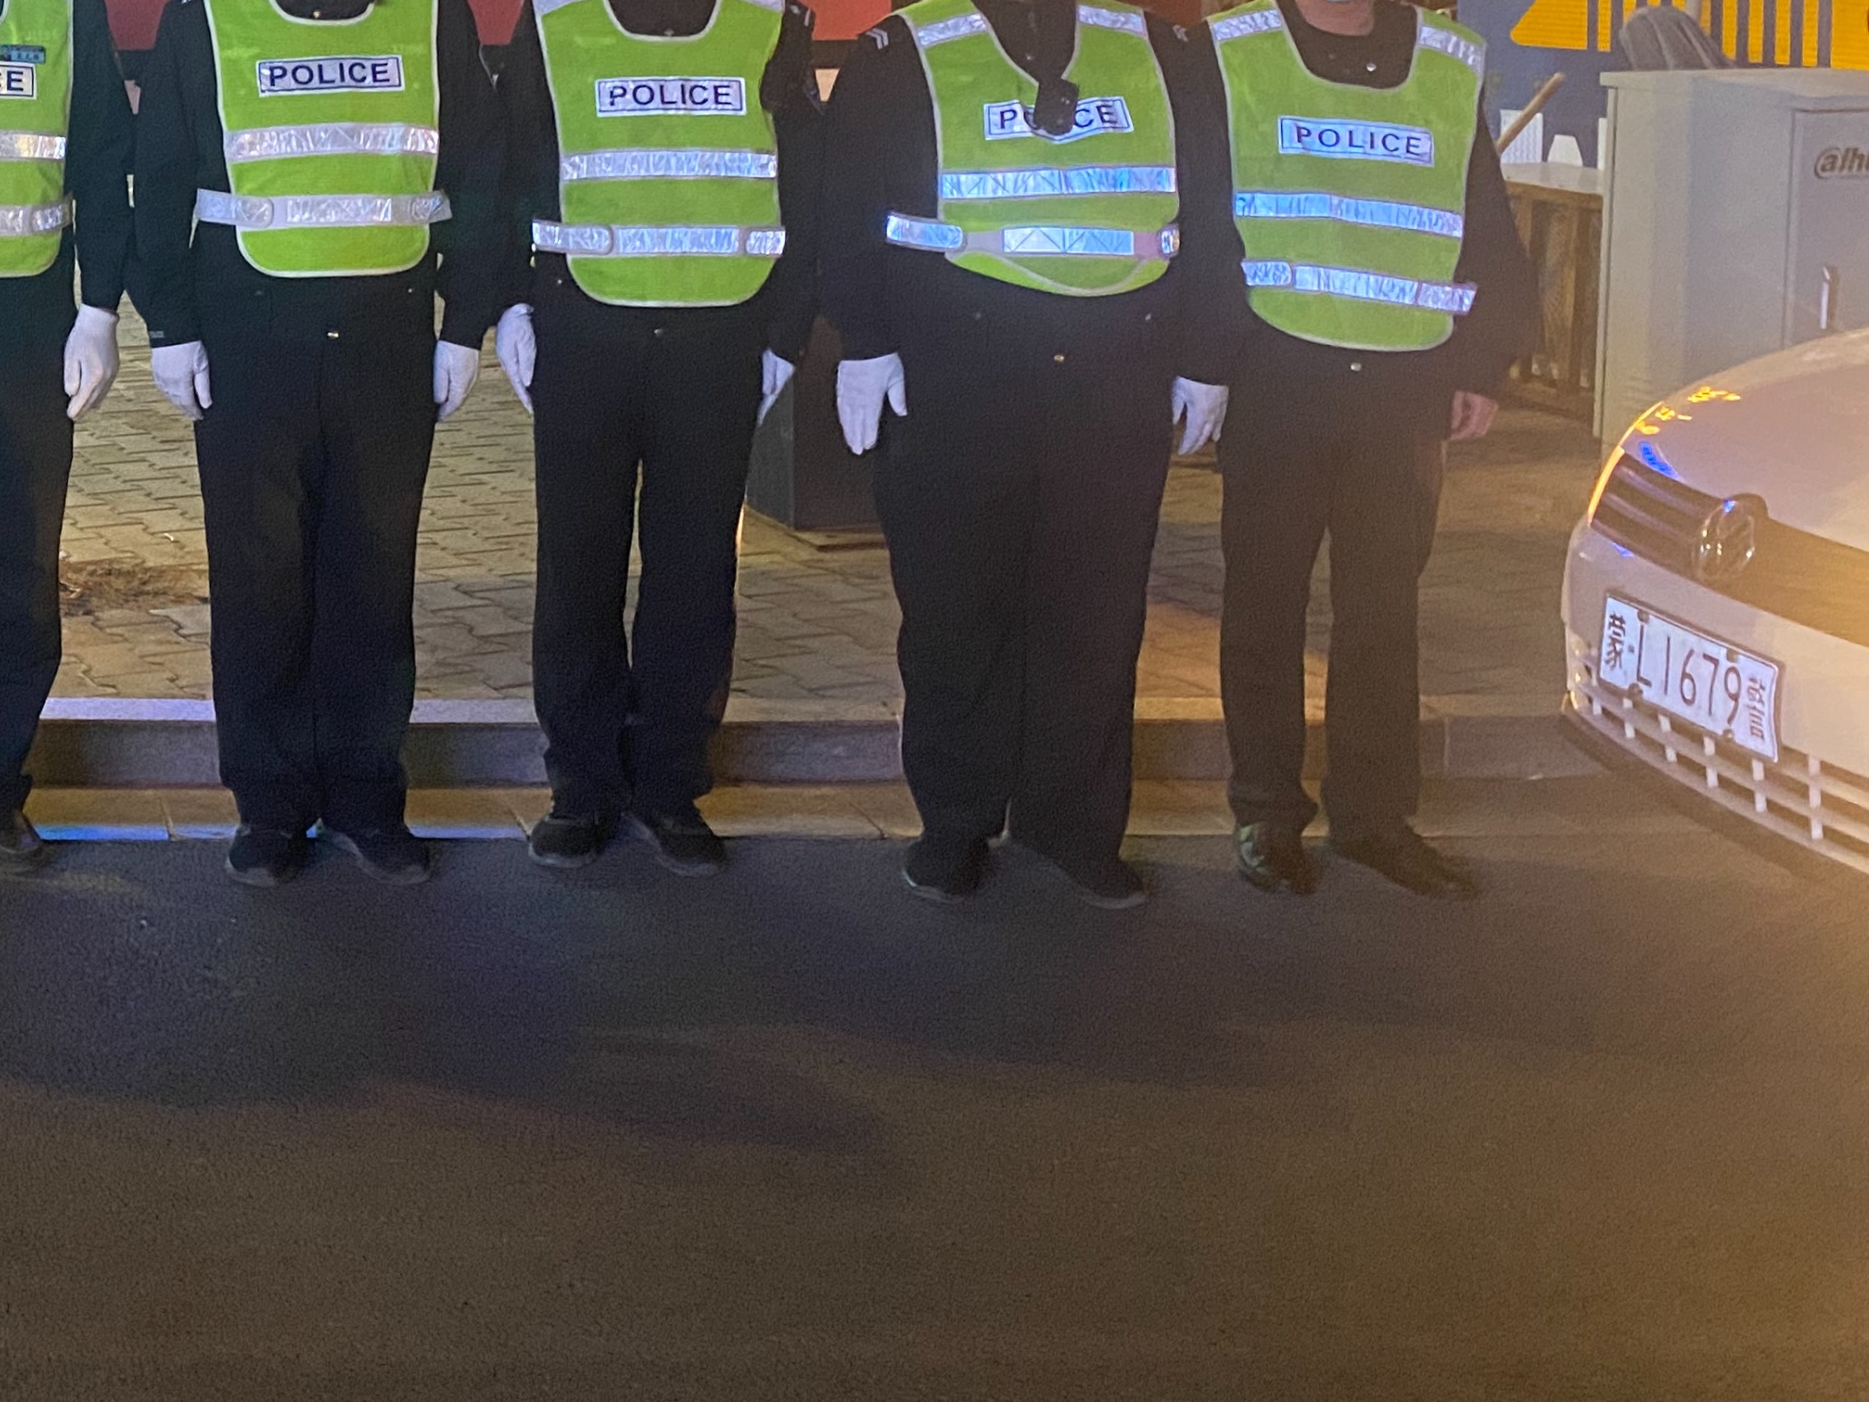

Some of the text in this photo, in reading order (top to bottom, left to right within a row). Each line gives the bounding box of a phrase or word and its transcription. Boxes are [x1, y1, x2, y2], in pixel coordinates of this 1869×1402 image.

[268, 63, 392, 87] POLICE
[608, 84, 733, 108] POLICE
[999, 105, 1118, 130] POCE
[1295, 125, 1423, 156] POLICE
